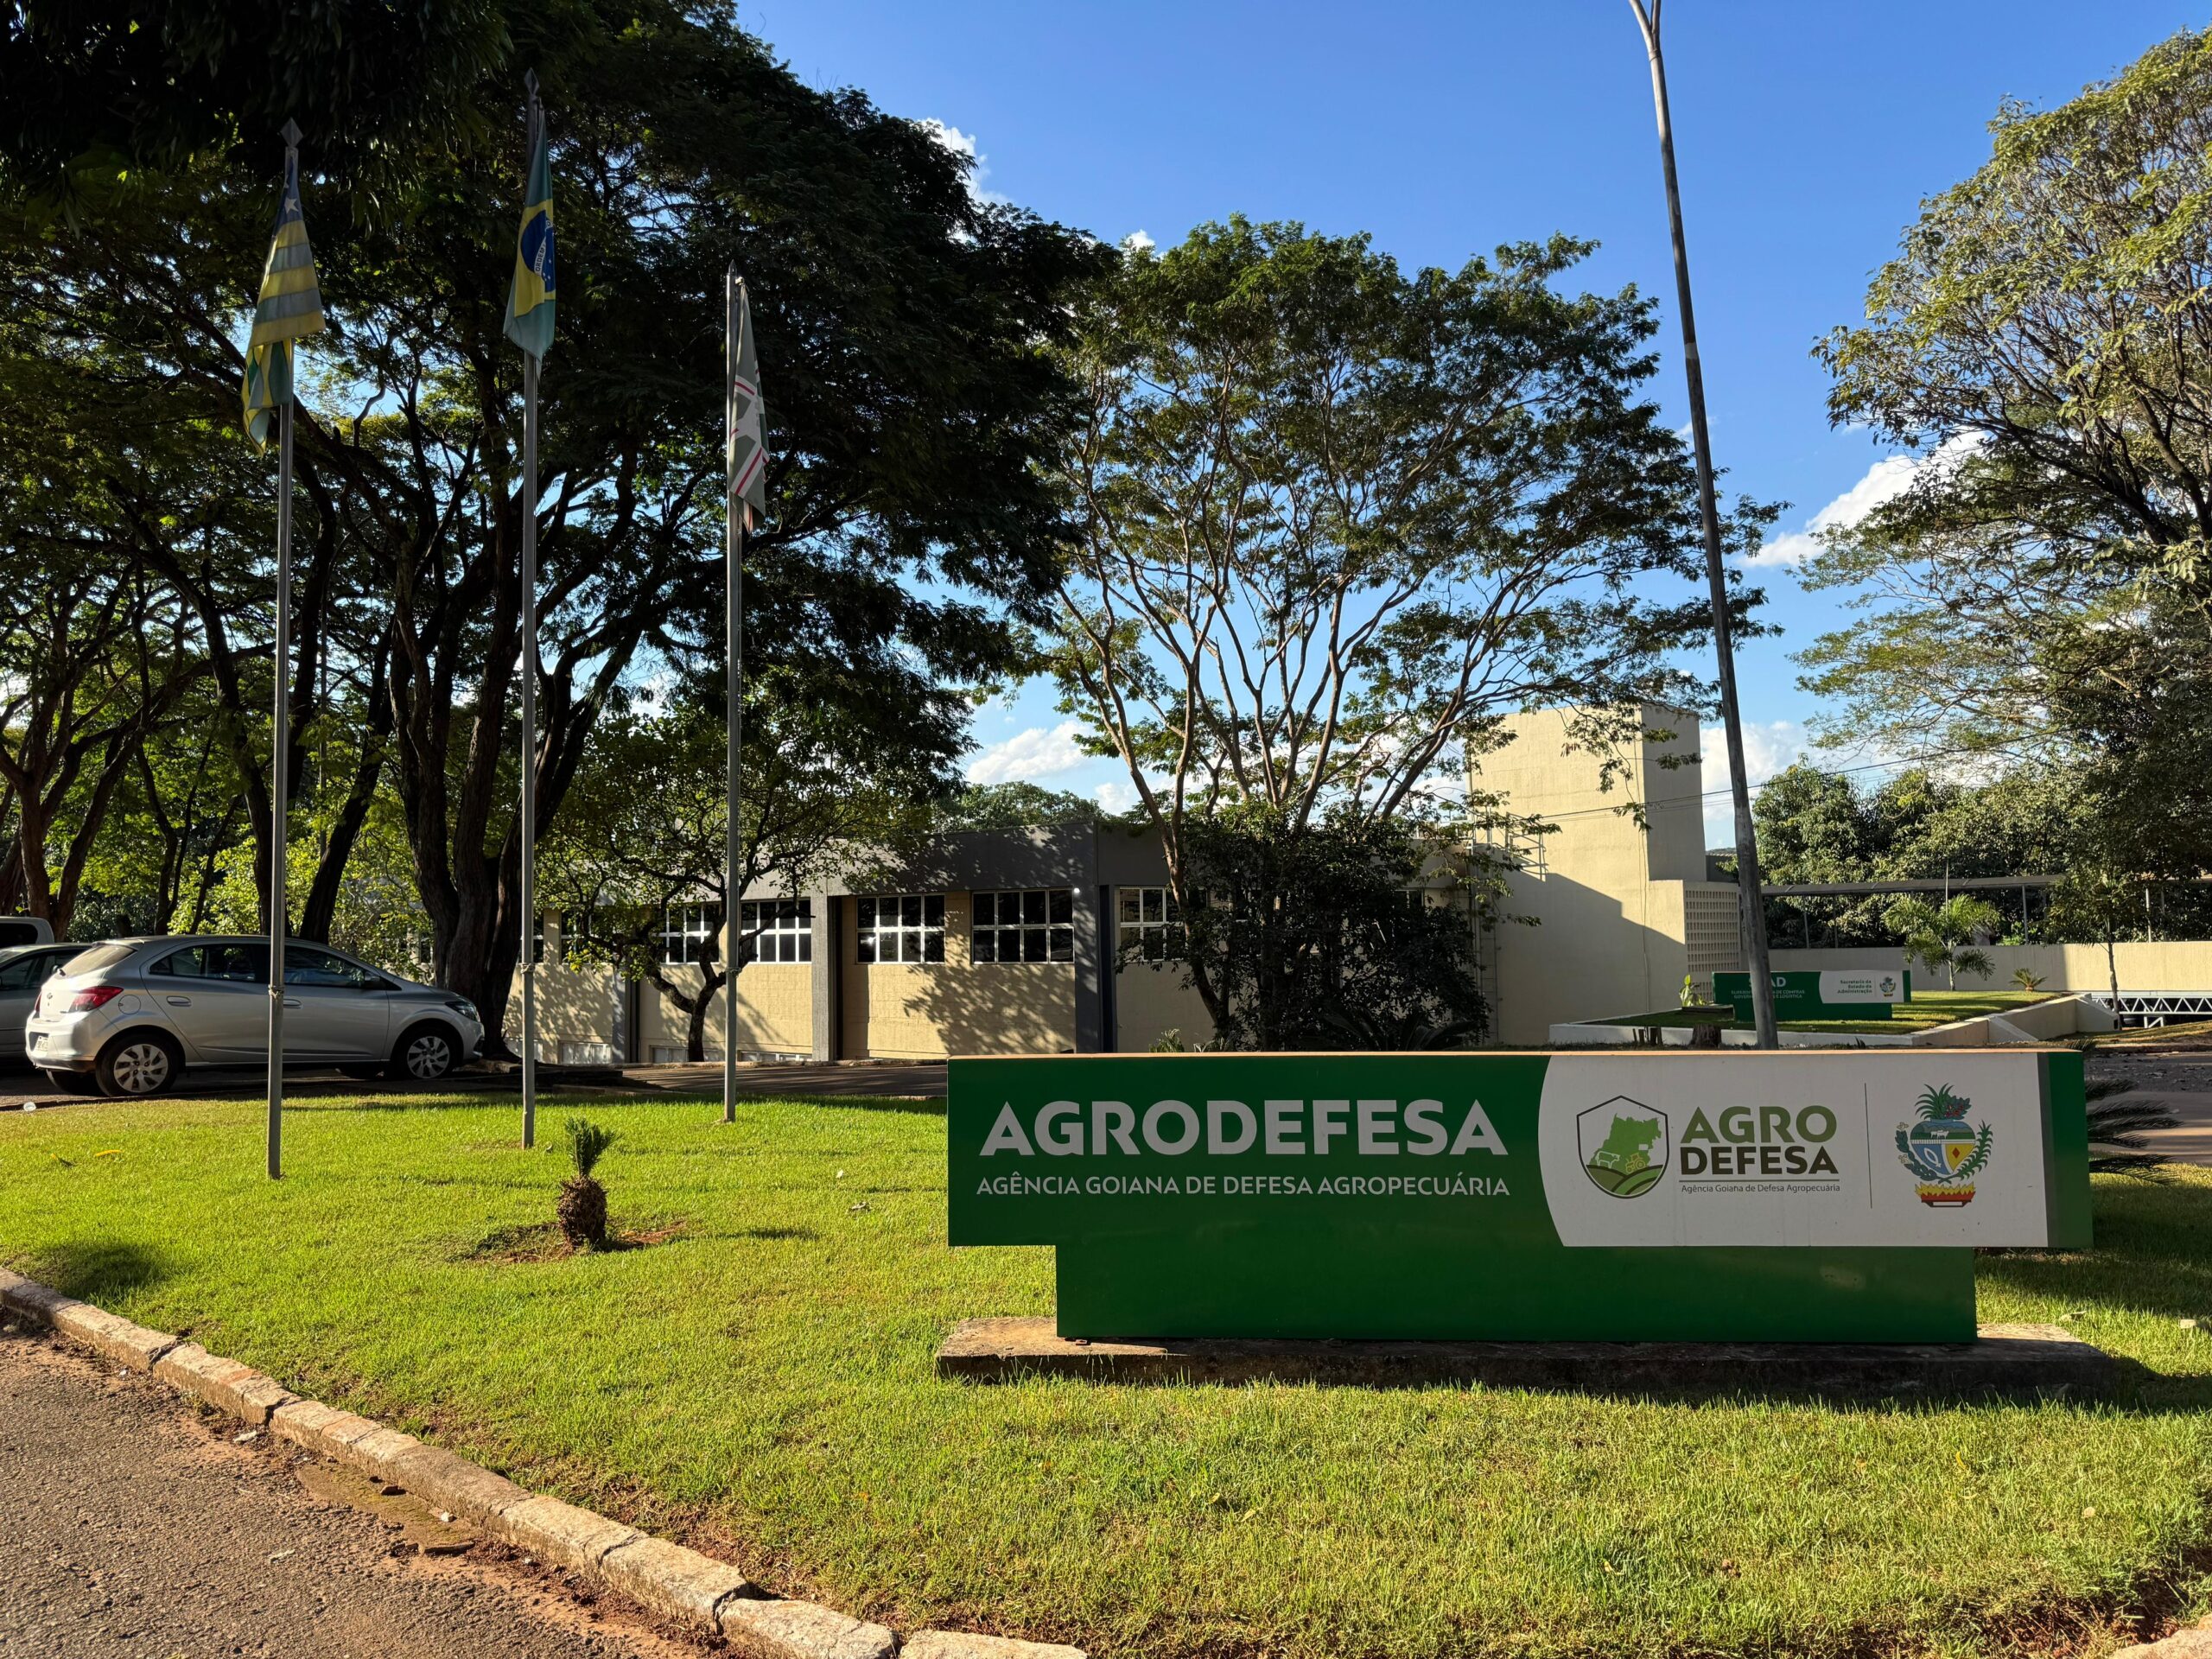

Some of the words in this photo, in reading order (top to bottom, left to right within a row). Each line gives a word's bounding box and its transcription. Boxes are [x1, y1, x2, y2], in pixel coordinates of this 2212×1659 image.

[536, 247, 545, 271] ORDEM
[979, 1099, 1509, 1156] AGRODEFESA
[1680, 1105, 1838, 1144] AGRO
[1680, 1145, 1840, 1176] DEFESA
[976, 1171, 1081, 1195] AGÊNCIA
[1085, 1176, 1180, 1194] GOIANA
[1186, 1176, 1217, 1194] DE
[1224, 1176, 1313, 1195] DEFESA
[1317, 1172, 1510, 1196] AGROPECUÁRIA
[1681, 1184, 1713, 1194] Agência
[1715, 1184, 1744, 1192] Goiana
[1745, 1184, 1756, 1192] de
[1758, 1184, 1785, 1192] Defesa
[1786, 1183, 1840, 1194] Agropecuária
